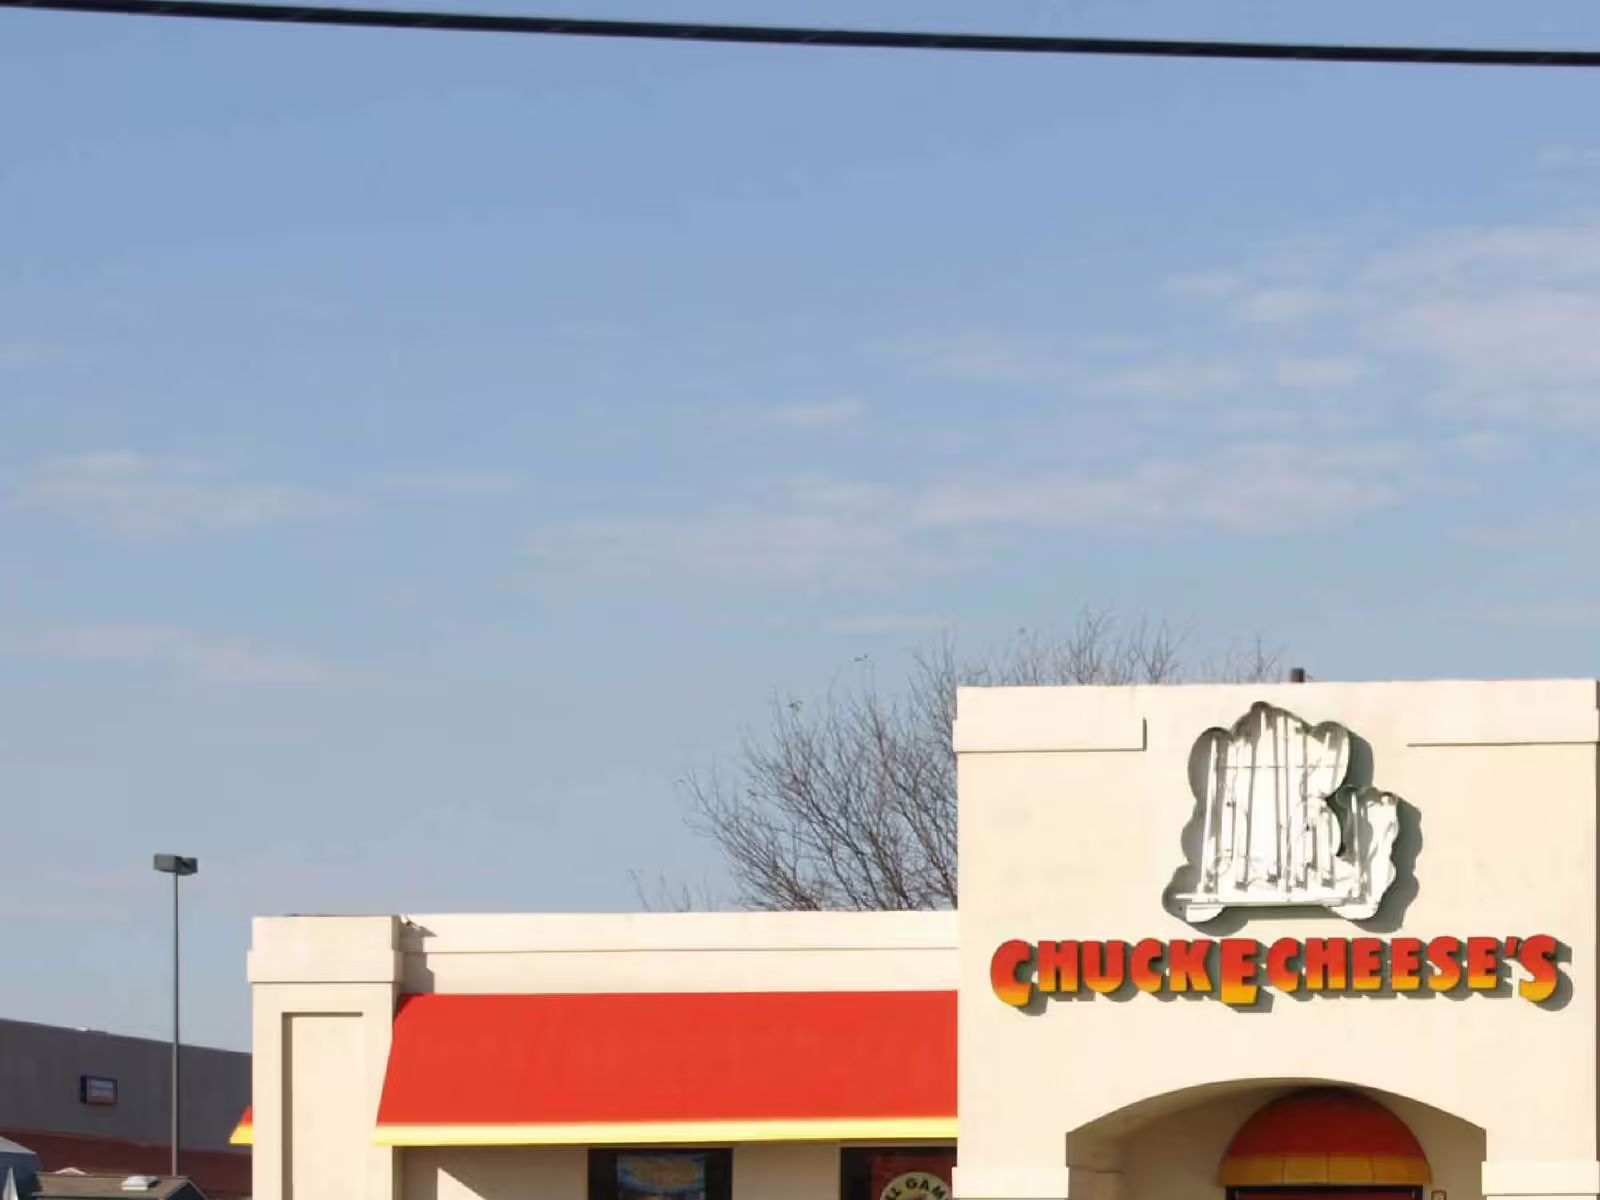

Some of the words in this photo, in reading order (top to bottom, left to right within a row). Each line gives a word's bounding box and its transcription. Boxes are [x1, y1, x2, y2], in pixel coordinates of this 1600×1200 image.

[990, 937, 1213, 1007] CHUCK
[1219, 937, 1260, 1005] E
[1265, 934, 1559, 1004] CHEESE'S
